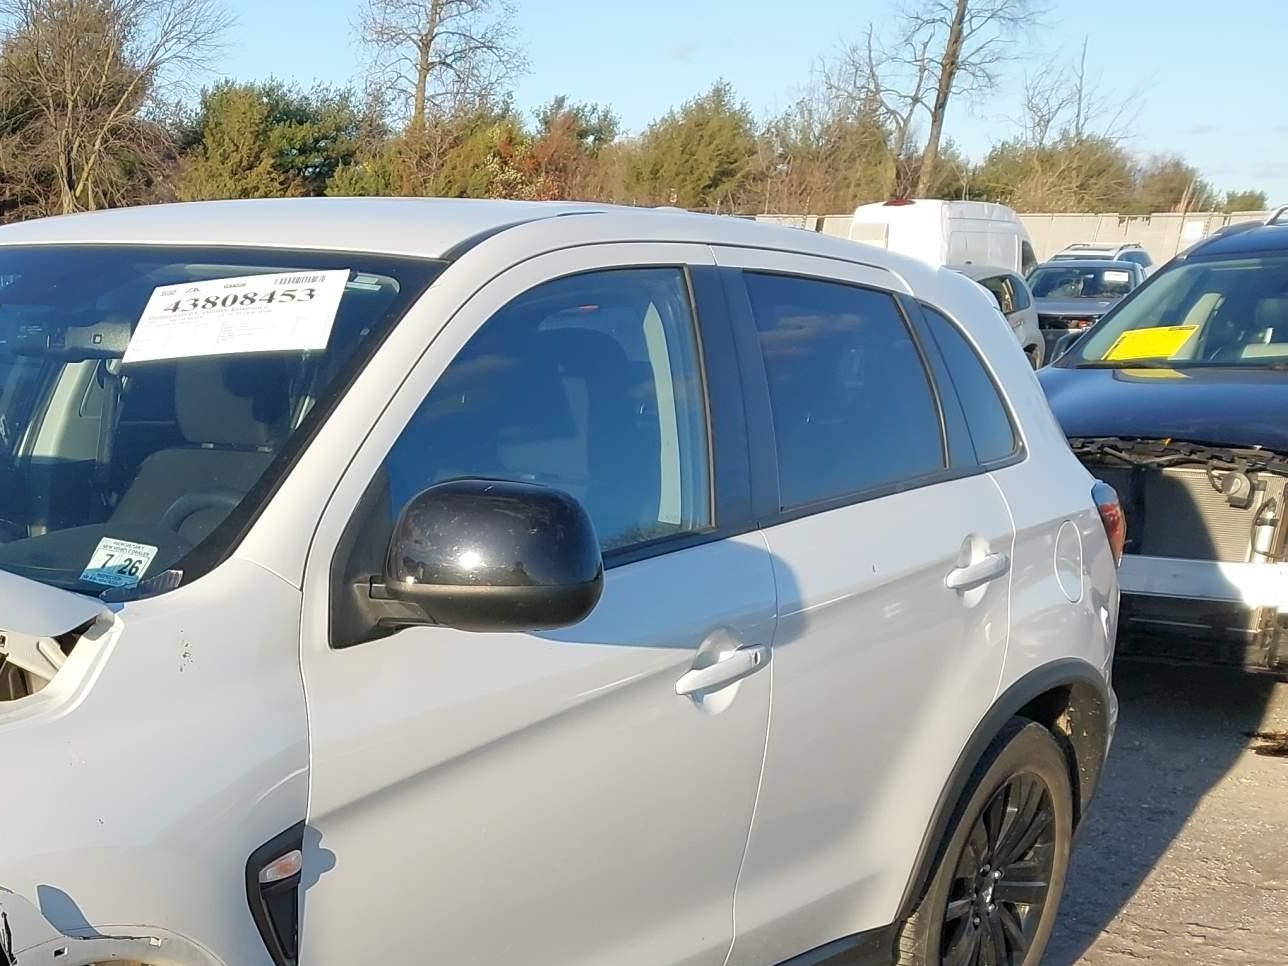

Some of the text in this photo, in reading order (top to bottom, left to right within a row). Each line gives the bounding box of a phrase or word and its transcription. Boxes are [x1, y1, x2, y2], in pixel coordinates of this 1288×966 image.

[163, 288, 316, 313] 43808453
[101, 553, 114, 568] 7
[118, 557, 143, 576] 26
